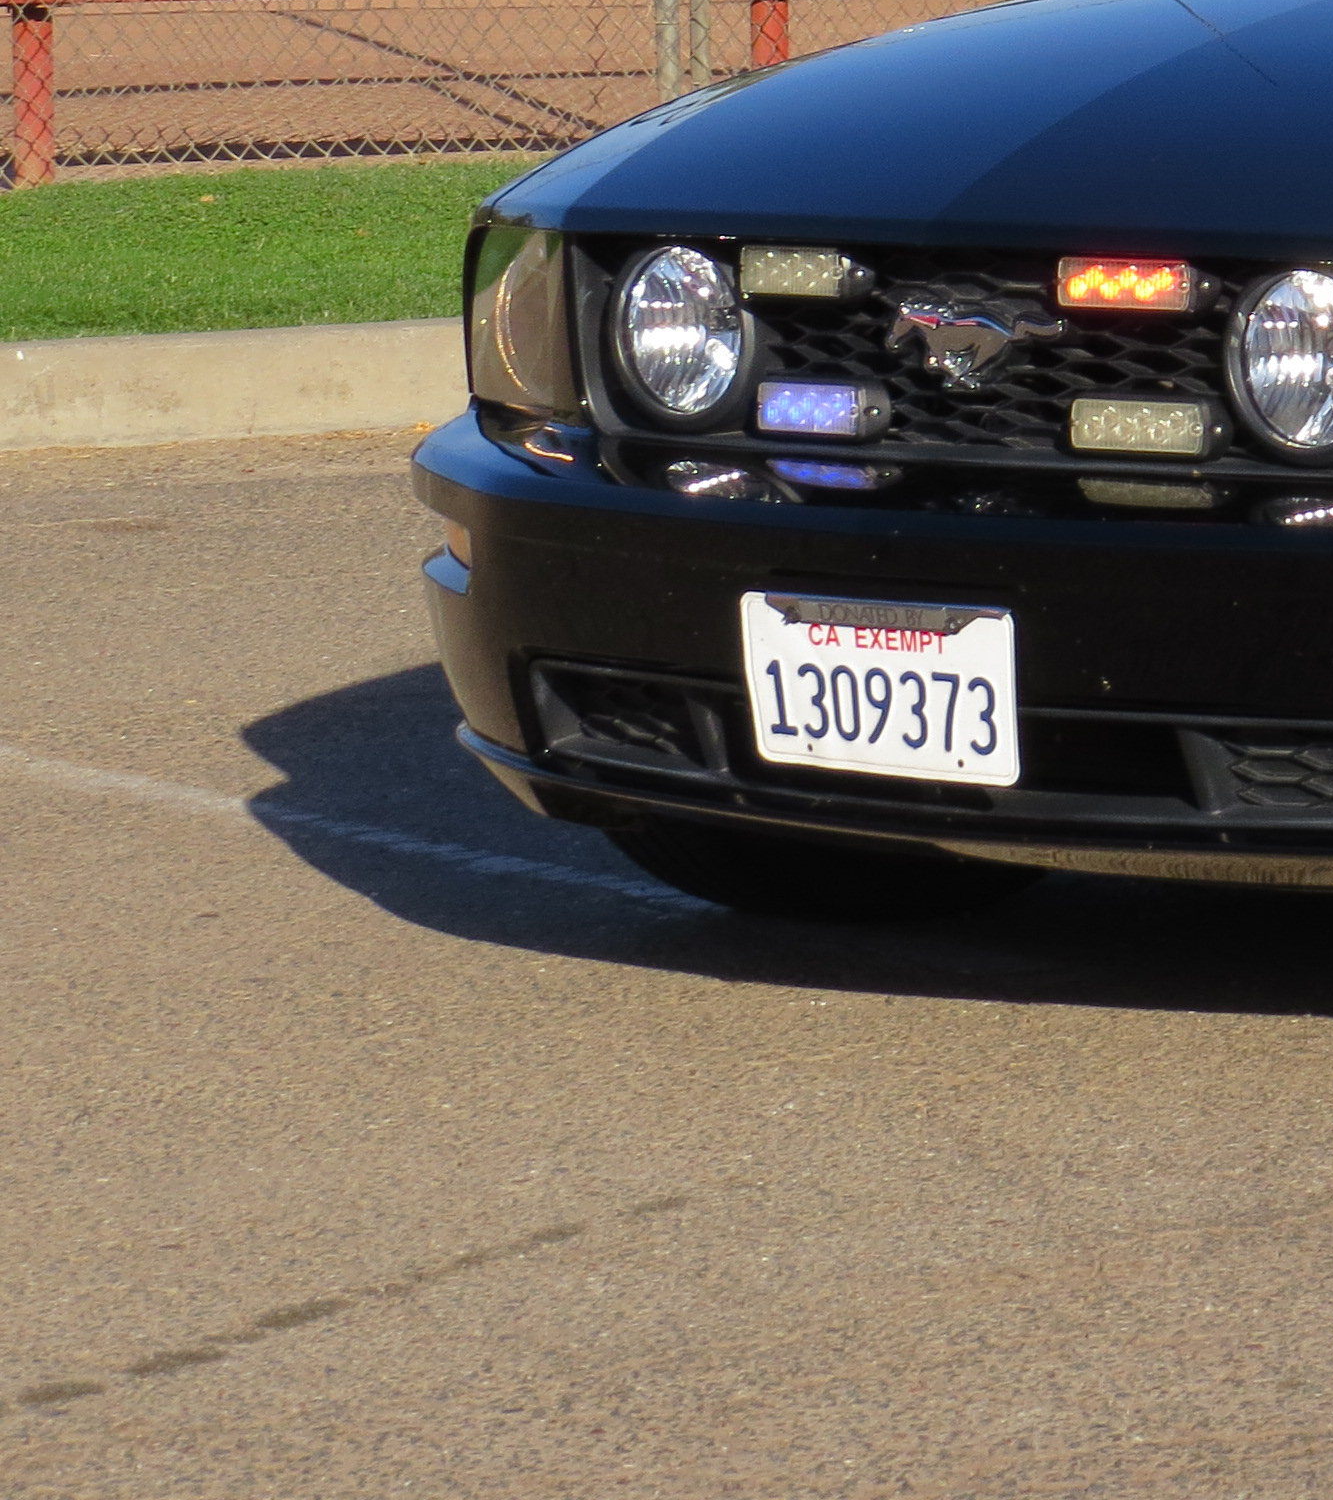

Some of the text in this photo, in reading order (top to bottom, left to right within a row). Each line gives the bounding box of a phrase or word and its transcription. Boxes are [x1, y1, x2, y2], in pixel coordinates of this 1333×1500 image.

[818, 602, 924, 628] DONATED BY
[808, 622, 945, 655] CA EXEMPT
[766, 659, 998, 756] 1309373
